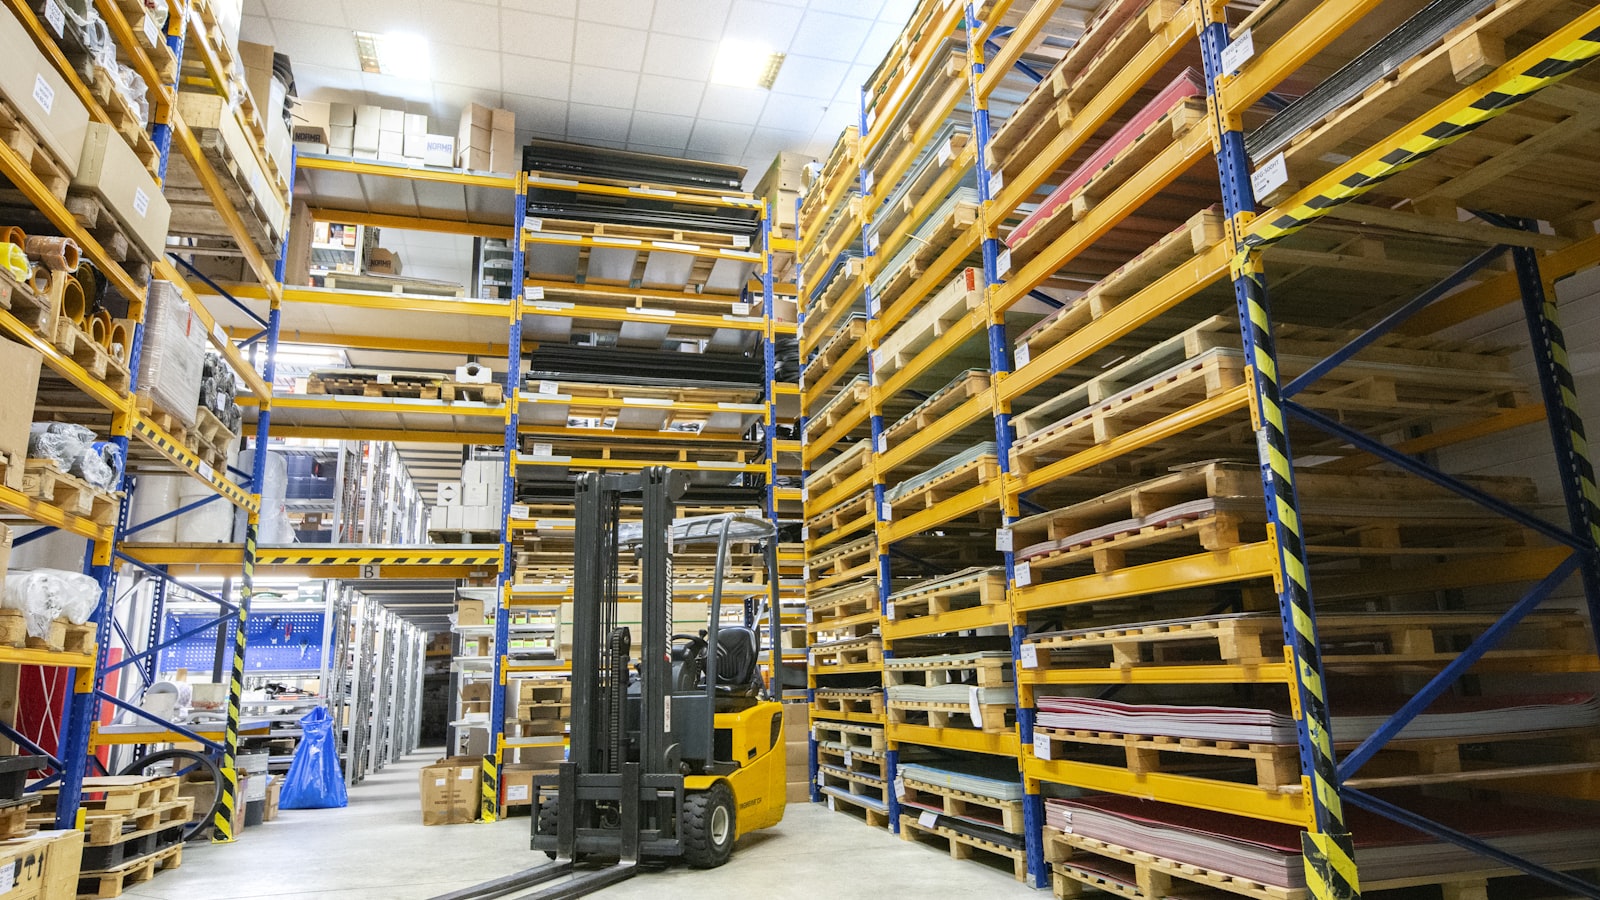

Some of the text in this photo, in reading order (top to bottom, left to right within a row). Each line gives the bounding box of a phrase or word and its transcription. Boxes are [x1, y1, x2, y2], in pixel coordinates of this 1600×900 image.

[295, 131, 321, 143] NORMA
[426, 141, 453, 154] NORMA
[370, 259, 392, 269] NORMA
[364, 565, 374, 578] B
[663, 558, 673, 663] JUNGHEINRICH
